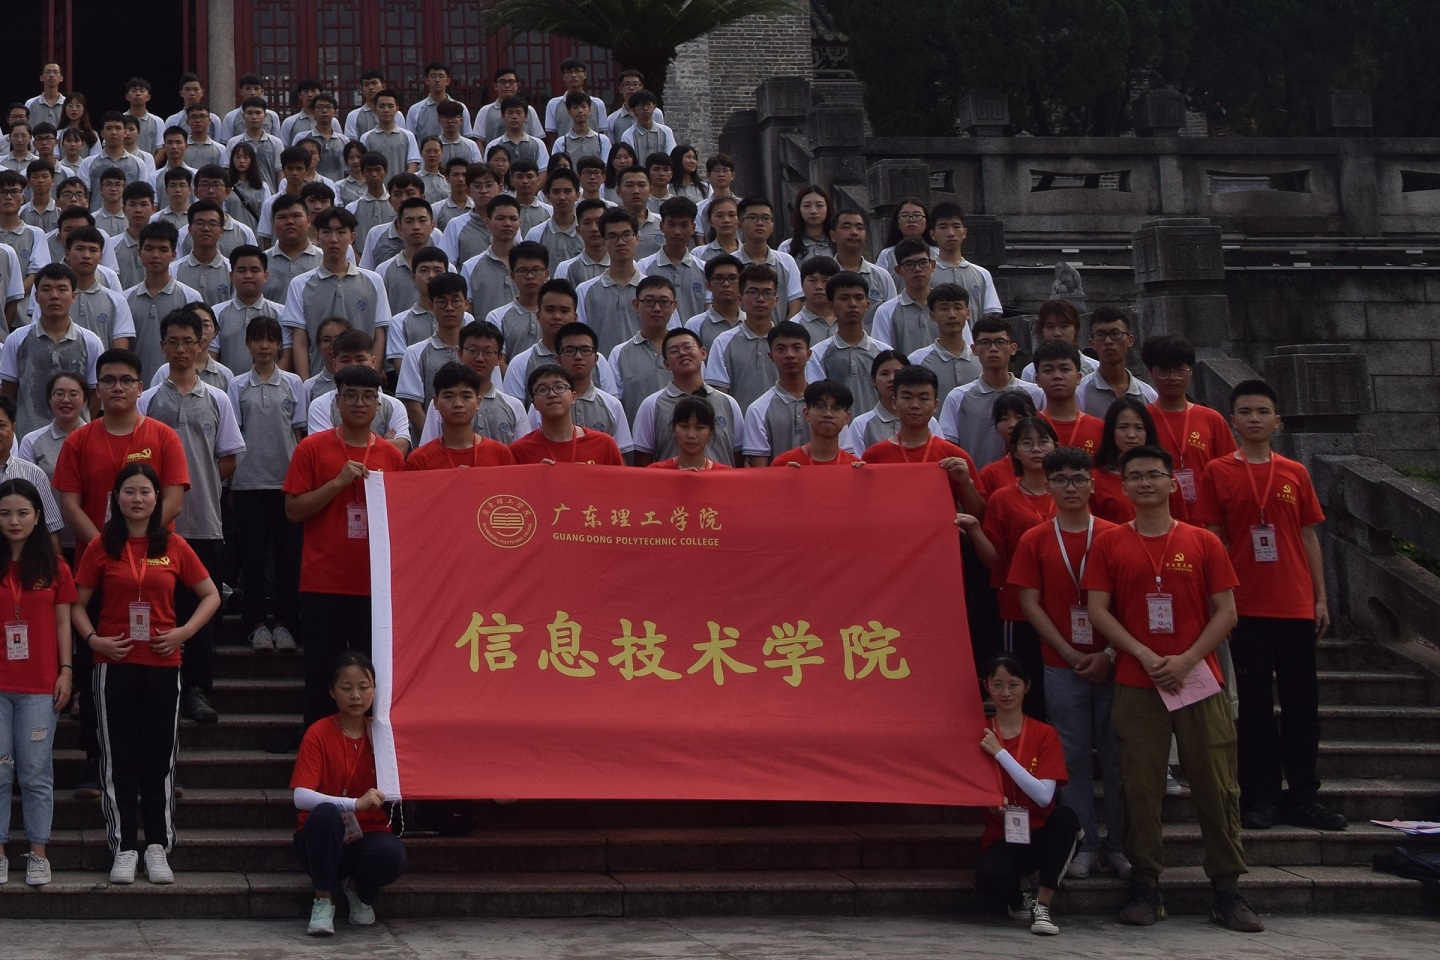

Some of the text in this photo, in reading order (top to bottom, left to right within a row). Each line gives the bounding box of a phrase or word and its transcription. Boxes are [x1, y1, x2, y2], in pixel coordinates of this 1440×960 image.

[551, 502, 722, 531] 广东理工学院
[616, 536, 677, 546] POLYTECHNIC
[680, 537, 719, 546] COLLEGE
[455, 610, 911, 687] 信息技术学院
